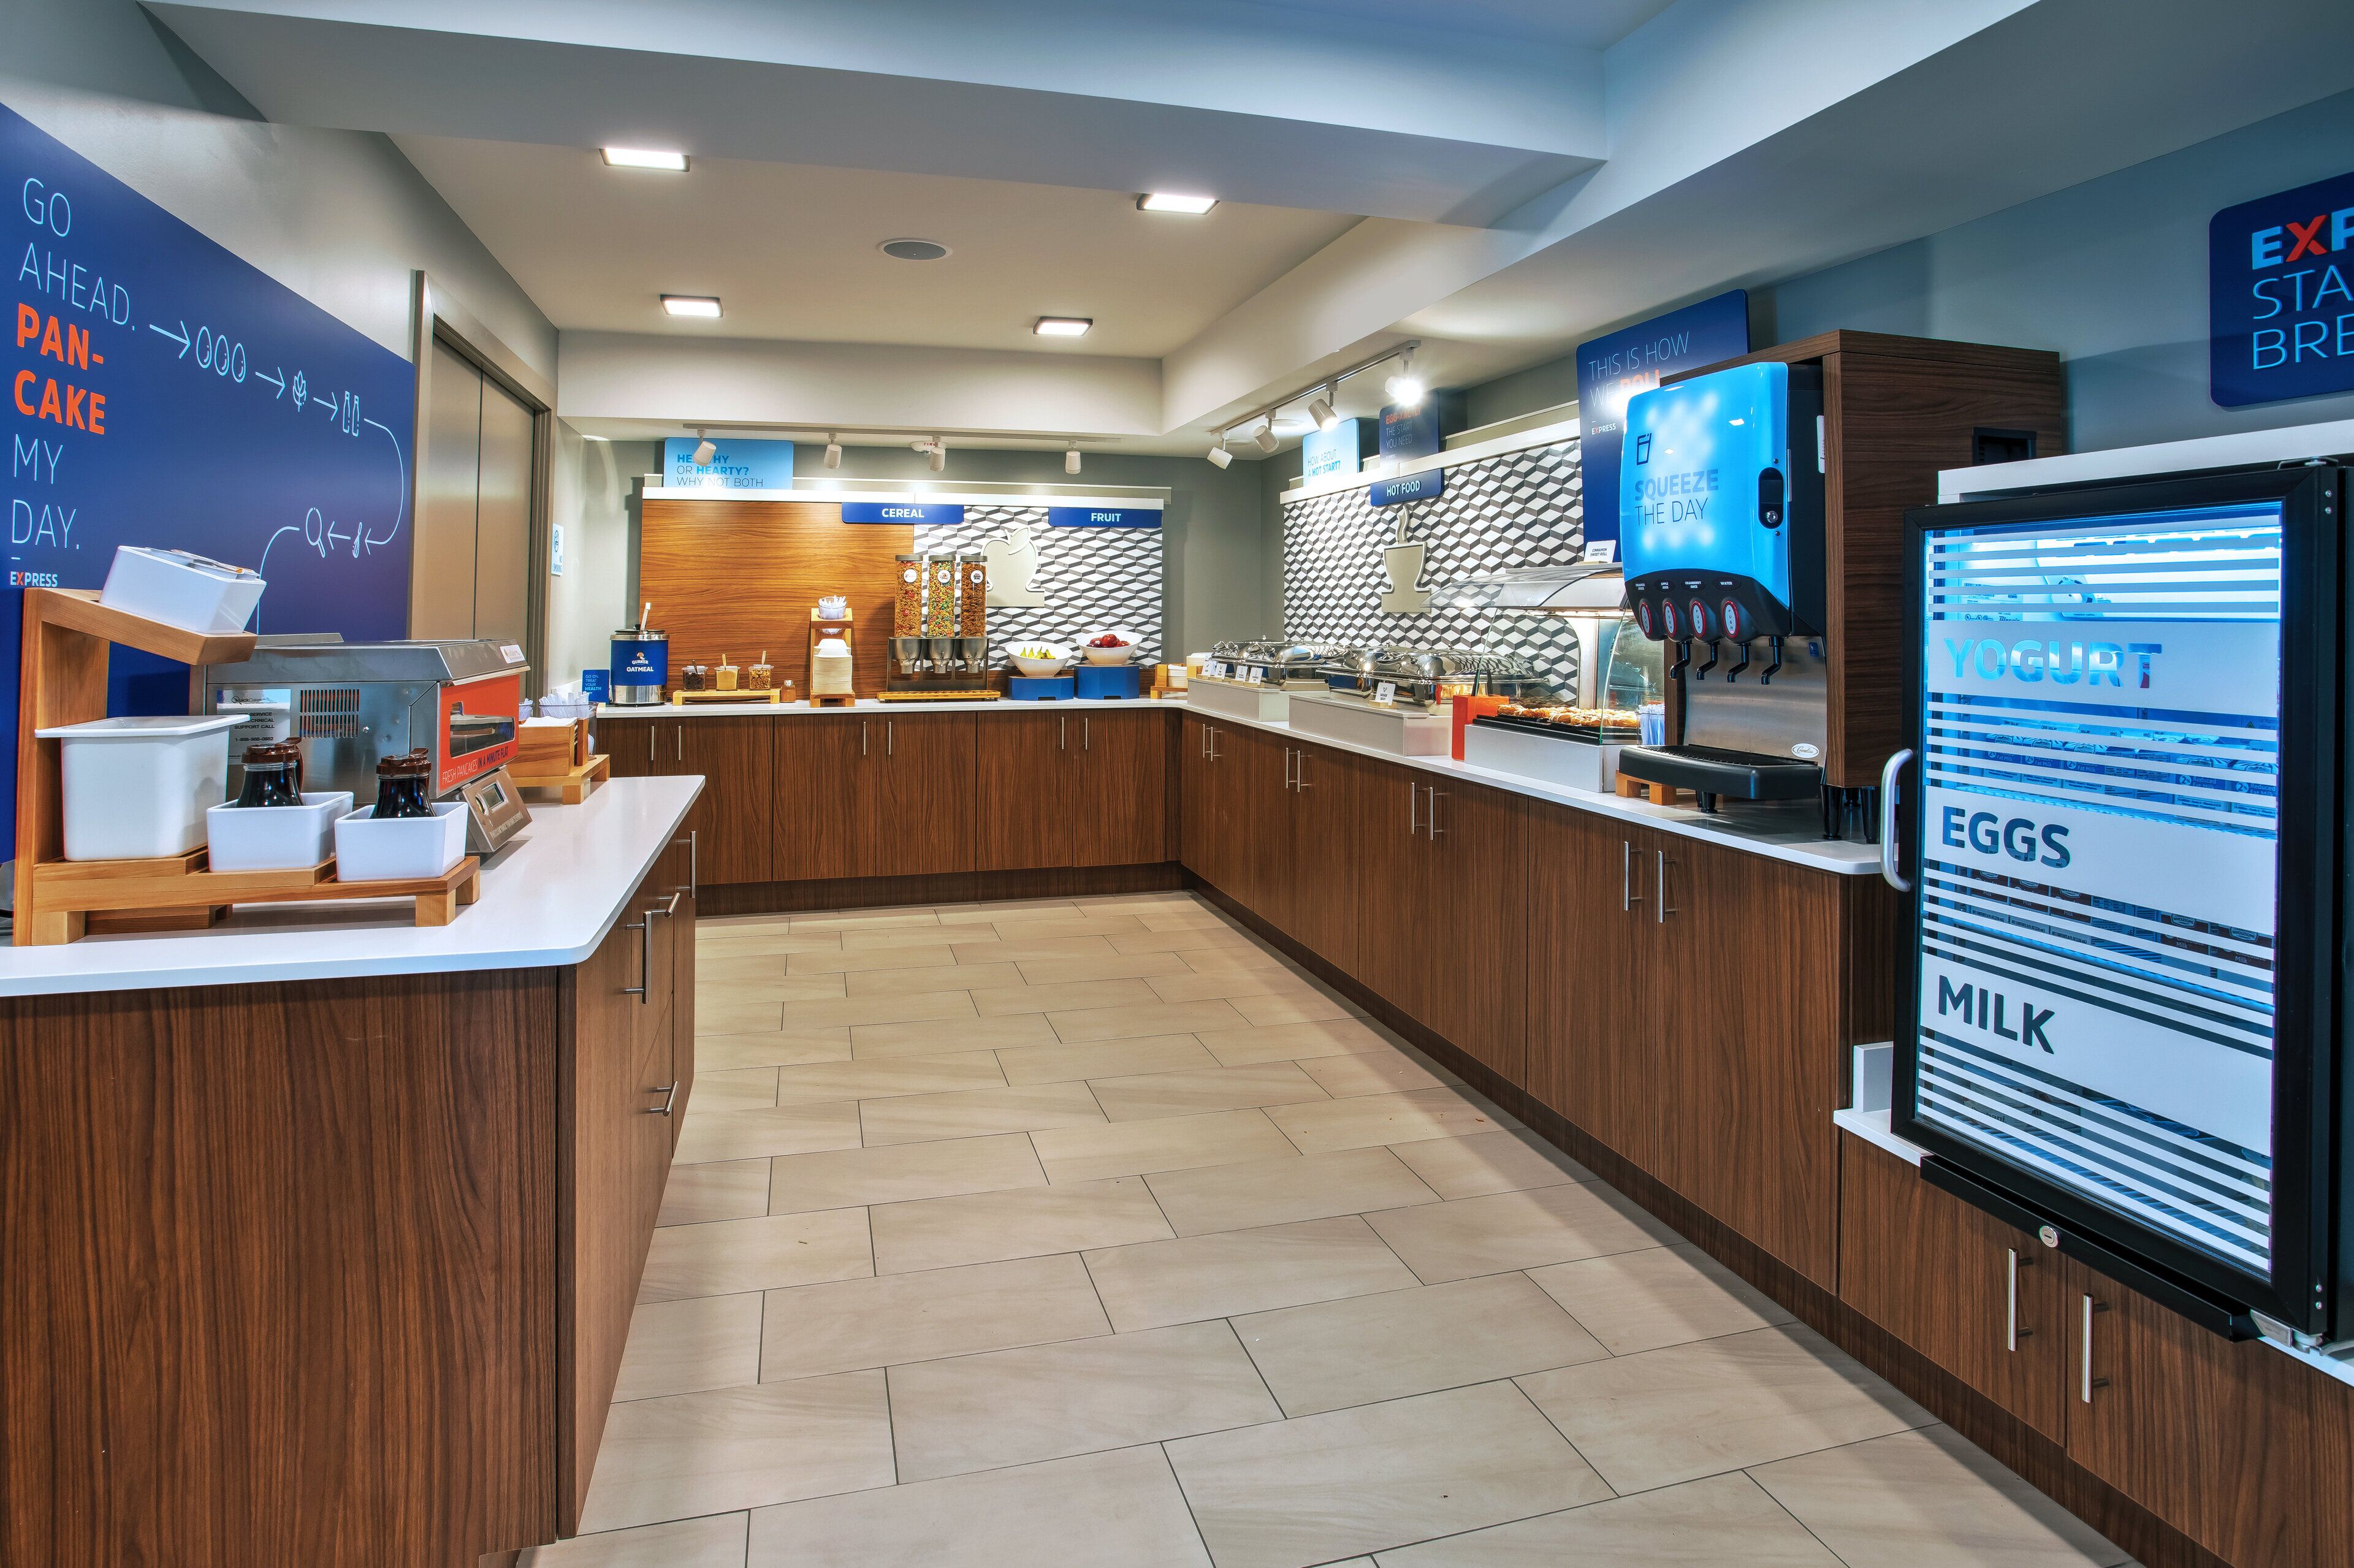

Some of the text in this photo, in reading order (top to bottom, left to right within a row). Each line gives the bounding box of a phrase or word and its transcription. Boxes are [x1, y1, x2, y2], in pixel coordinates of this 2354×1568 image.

[23, 178, 72, 237] GO
[18, 242, 135, 331] AHEAD.
[2253, 265, 2354, 319] STA
[17, 302, 105, 371] PAN-
[1588, 330, 1689, 381] THIS IS HOW
[13, 369, 105, 435] CAKE
[1589, 382, 1613, 408] WE
[1385, 421, 1413, 437] THE START
[1385, 434, 1412, 449] YOU NEED
[1591, 423, 1617, 435] EXPRESS
[13, 433, 63, 484] MY
[677, 454, 729, 464] HEHY
[677, 465, 749, 476] OR HEARTY?
[1308, 449, 1337, 466] HOW ABOUT
[1312, 466, 1322, 477] HOT
[1323, 460, 1341, 474] START?
[676, 477, 763, 487] WHY NOT BOTH
[1387, 480, 1421, 497] HOT FOOD
[1634, 468, 1719, 501] SQUEEZE
[10, 498, 80, 550] DAY.
[881, 508, 925, 518] CEREAL
[1091, 512, 1122, 522] FRUIT
[1634, 497, 1708, 526] THE DAY
[1943, 637, 2162, 688] YOGURT
[442, 746, 509, 785] FRESH PANCAKES IN A MINUTE FLAT
[1942, 805, 2071, 869] EGGS
[2176, 941, 2188, 950] Milk
[2235, 956, 2247, 964] Milk
[1938, 975, 2055, 1054] MILK
